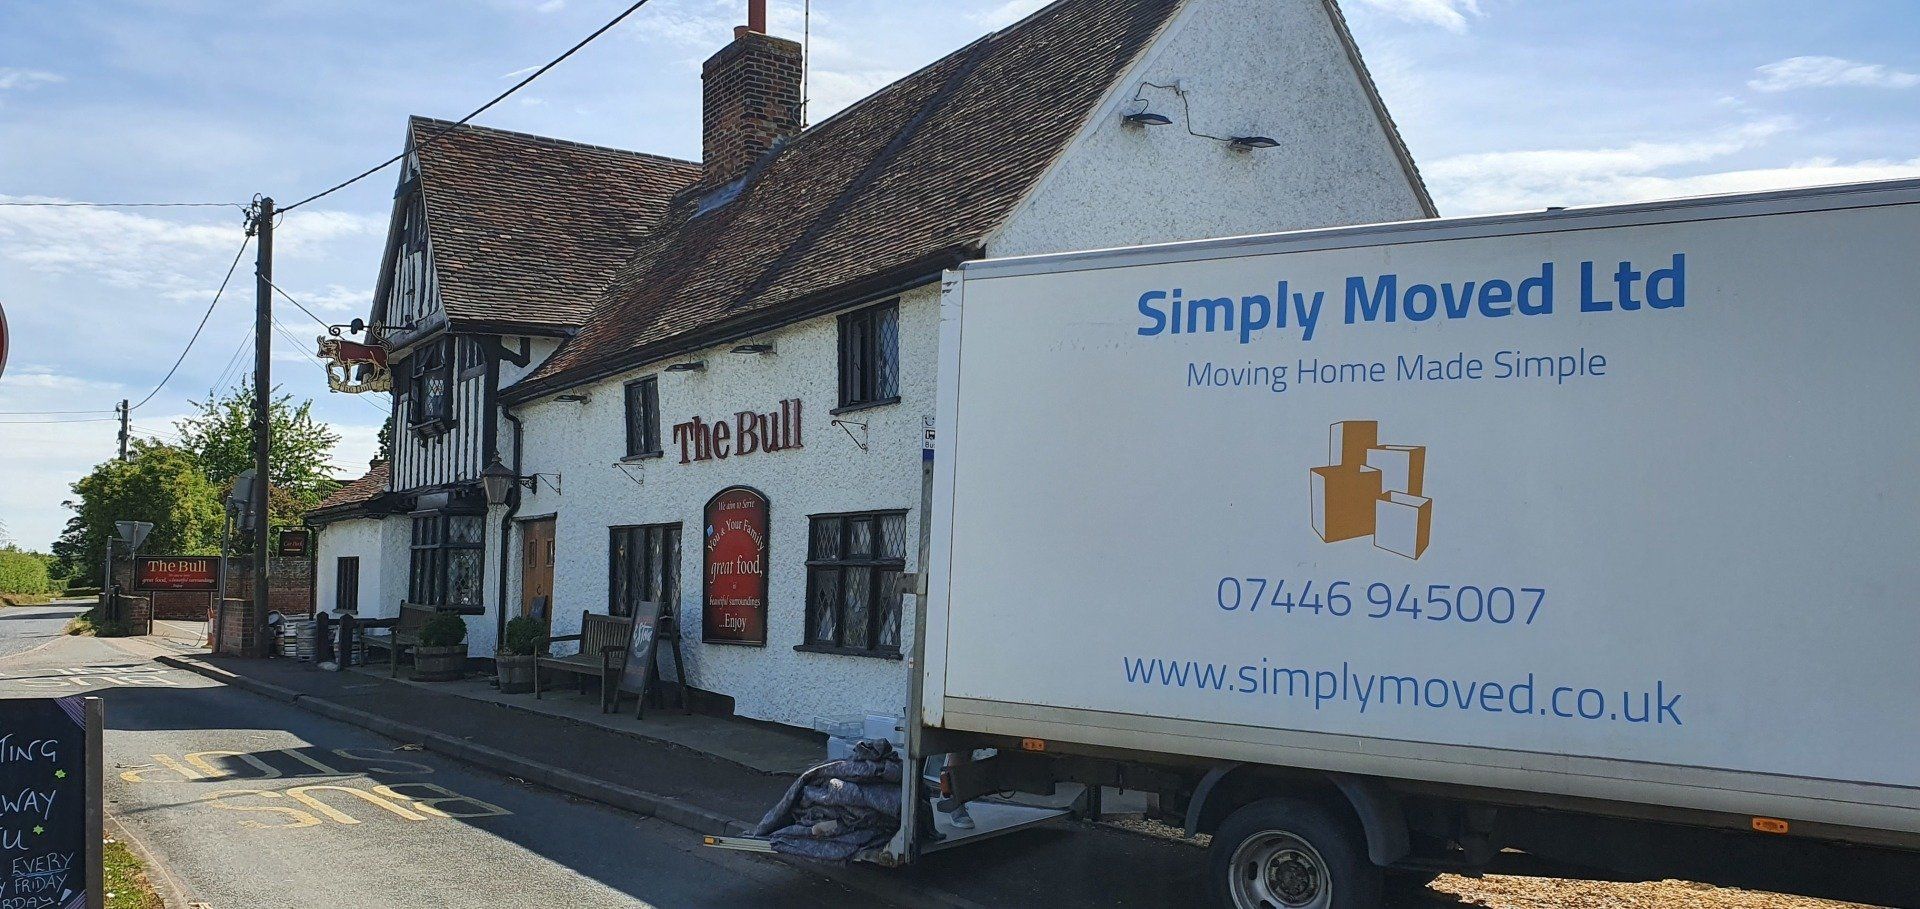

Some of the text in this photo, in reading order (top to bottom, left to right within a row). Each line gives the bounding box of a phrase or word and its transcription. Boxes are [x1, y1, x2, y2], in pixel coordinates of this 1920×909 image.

[1136, 252, 1687, 345] Simply Moved Ltd
[1186, 347, 1607, 395] Moving Home Made Simple
[672, 398, 804, 464] The Bull
[708, 533, 720, 551] You
[725, 518, 743, 531] Your
[743, 519, 765, 551] Family
[147, 560, 207, 573] The Bull
[709, 554, 763, 584] great food,
[709, 594, 761, 610] beautiful surroundings
[1216, 575, 1546, 625] 07446 945007
[1123, 656, 1685, 727] www.simplymoved.co.uk
[0, 788, 56, 820] WAY
[200, 782, 514, 829] BUS
[0, 827, 29, 850] U
[12, 852, 74, 875] EVERY
[15, 873, 68, 894] FRIDAY
